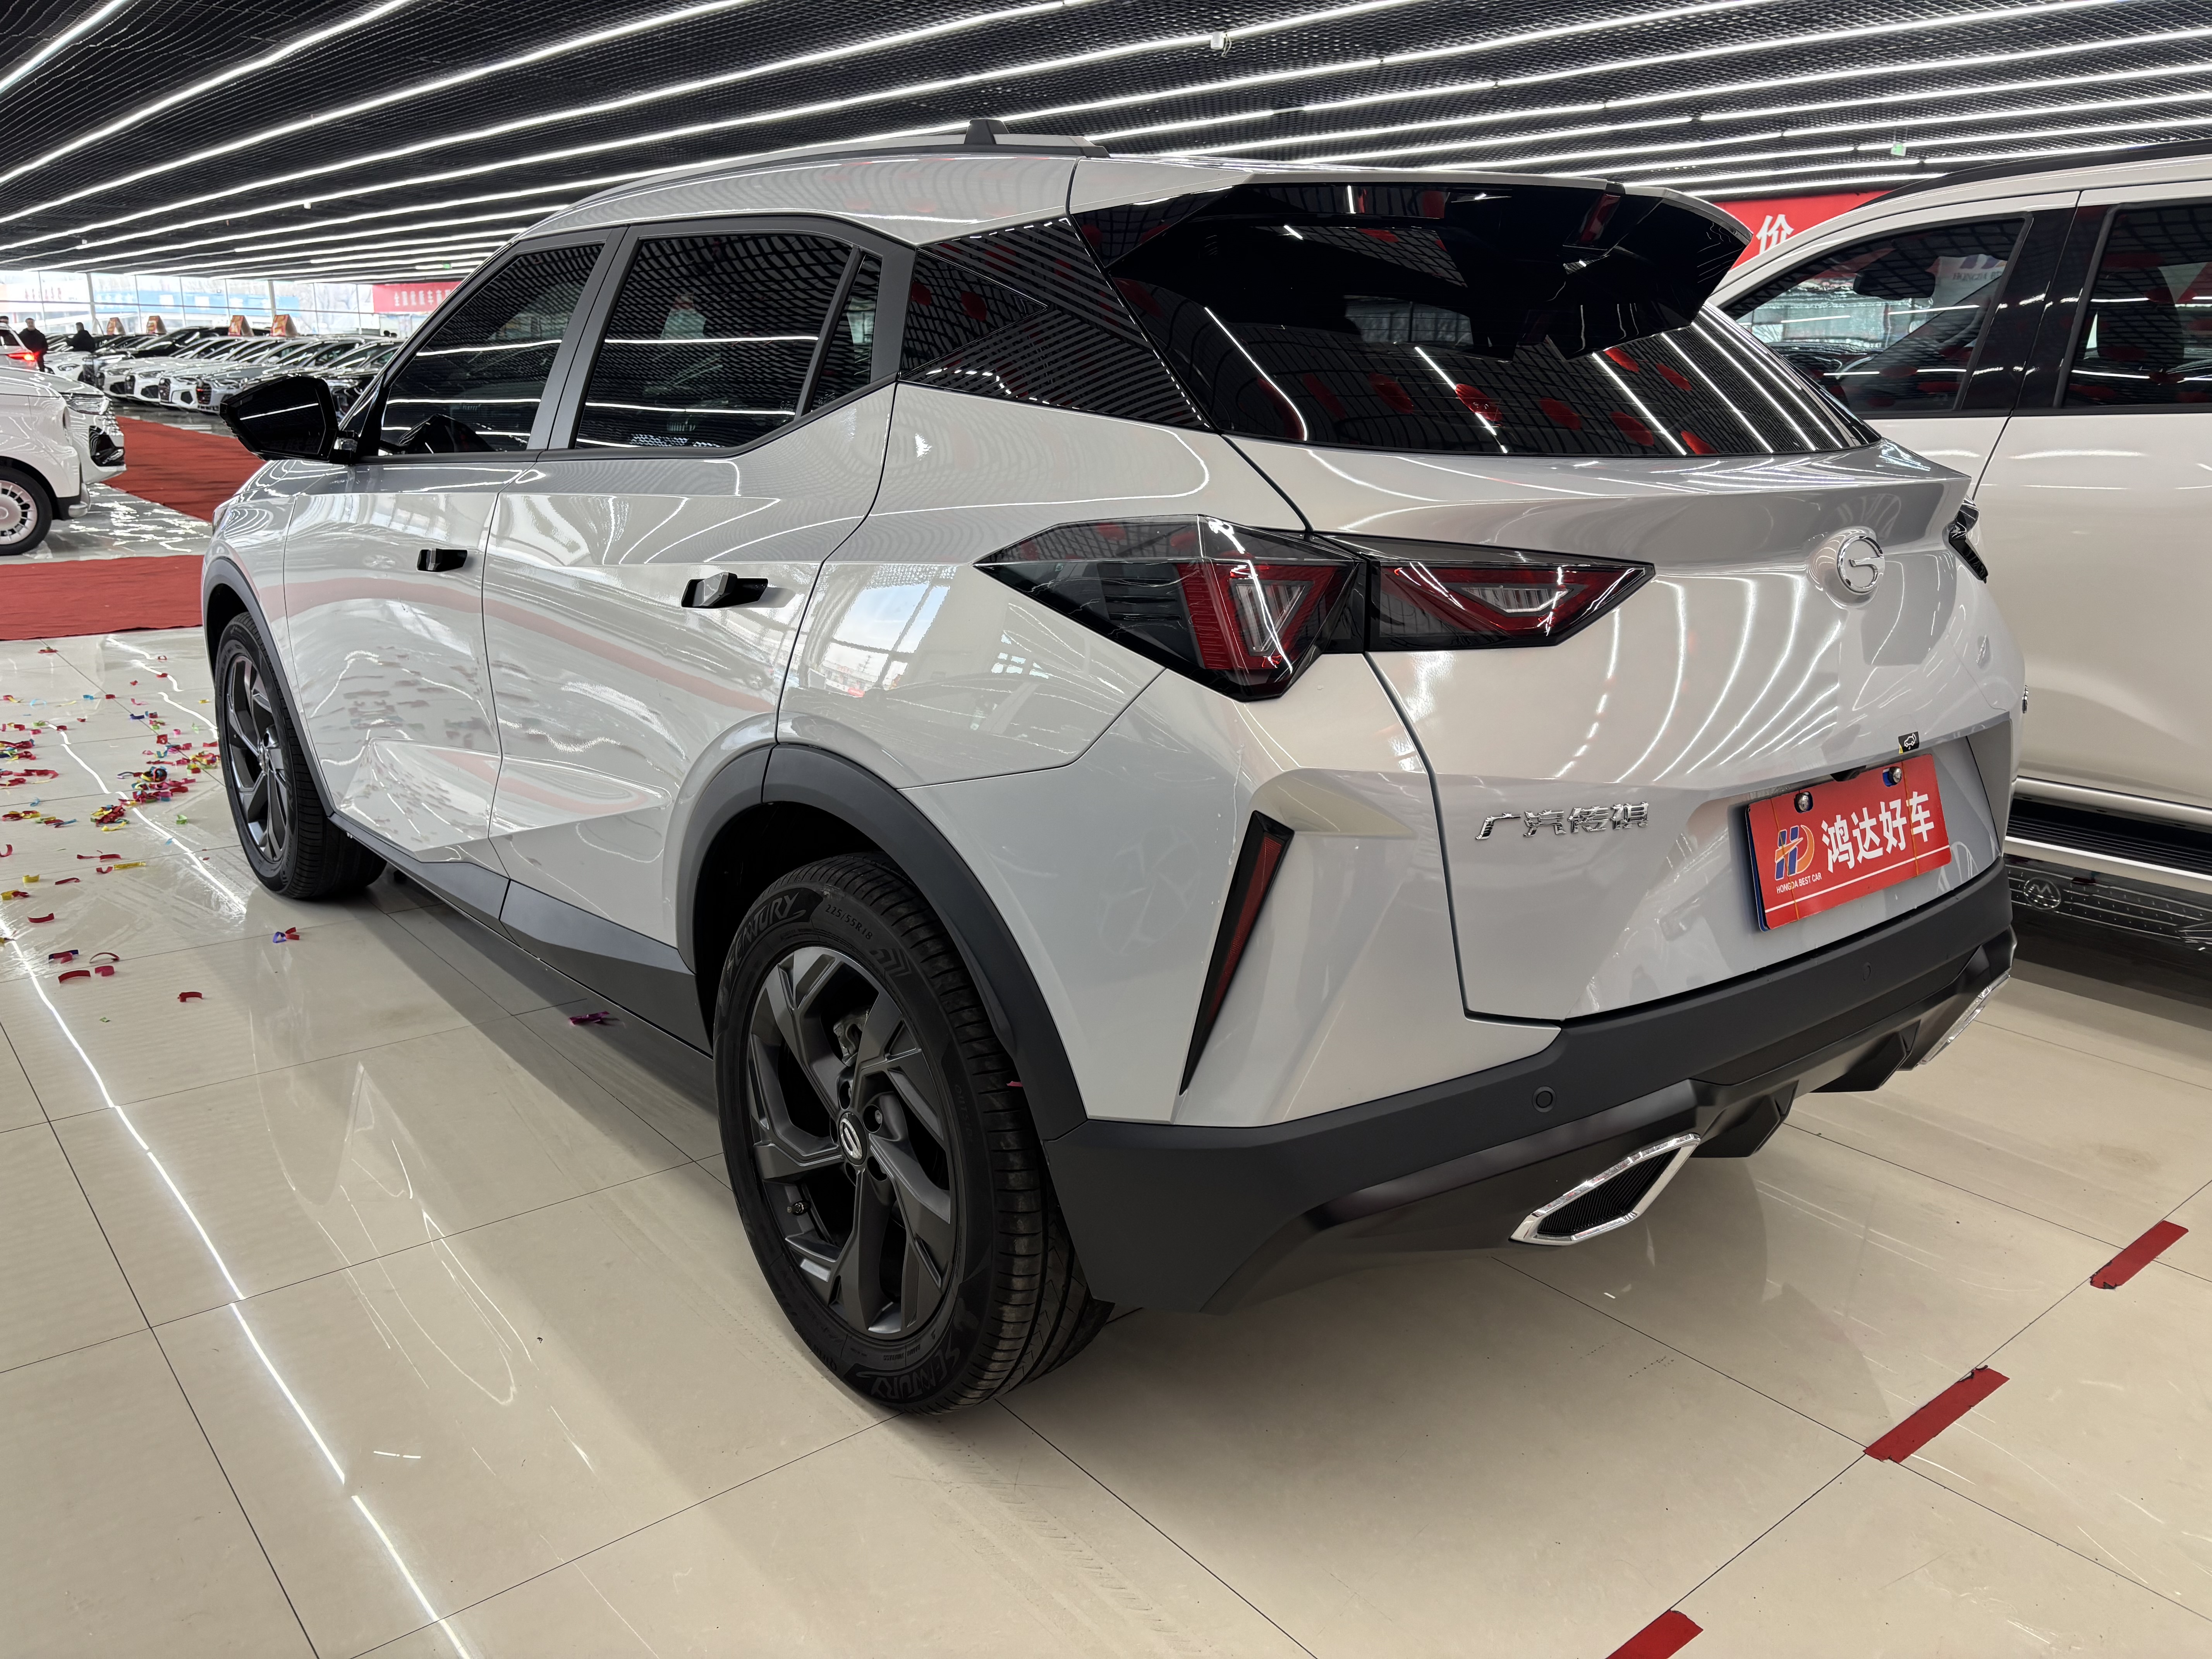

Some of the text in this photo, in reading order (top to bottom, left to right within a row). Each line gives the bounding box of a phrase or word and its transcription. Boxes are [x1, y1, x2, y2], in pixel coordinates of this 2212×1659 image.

[1755, 214, 1794, 254] 价
[1475, 801, 1649, 840] 广汽传祺
[1822, 791, 1934, 873] 鸿达好车
[1776, 872, 1822, 894] HONGDA BEST CAR
[825, 904, 873, 940] 225/55R18
